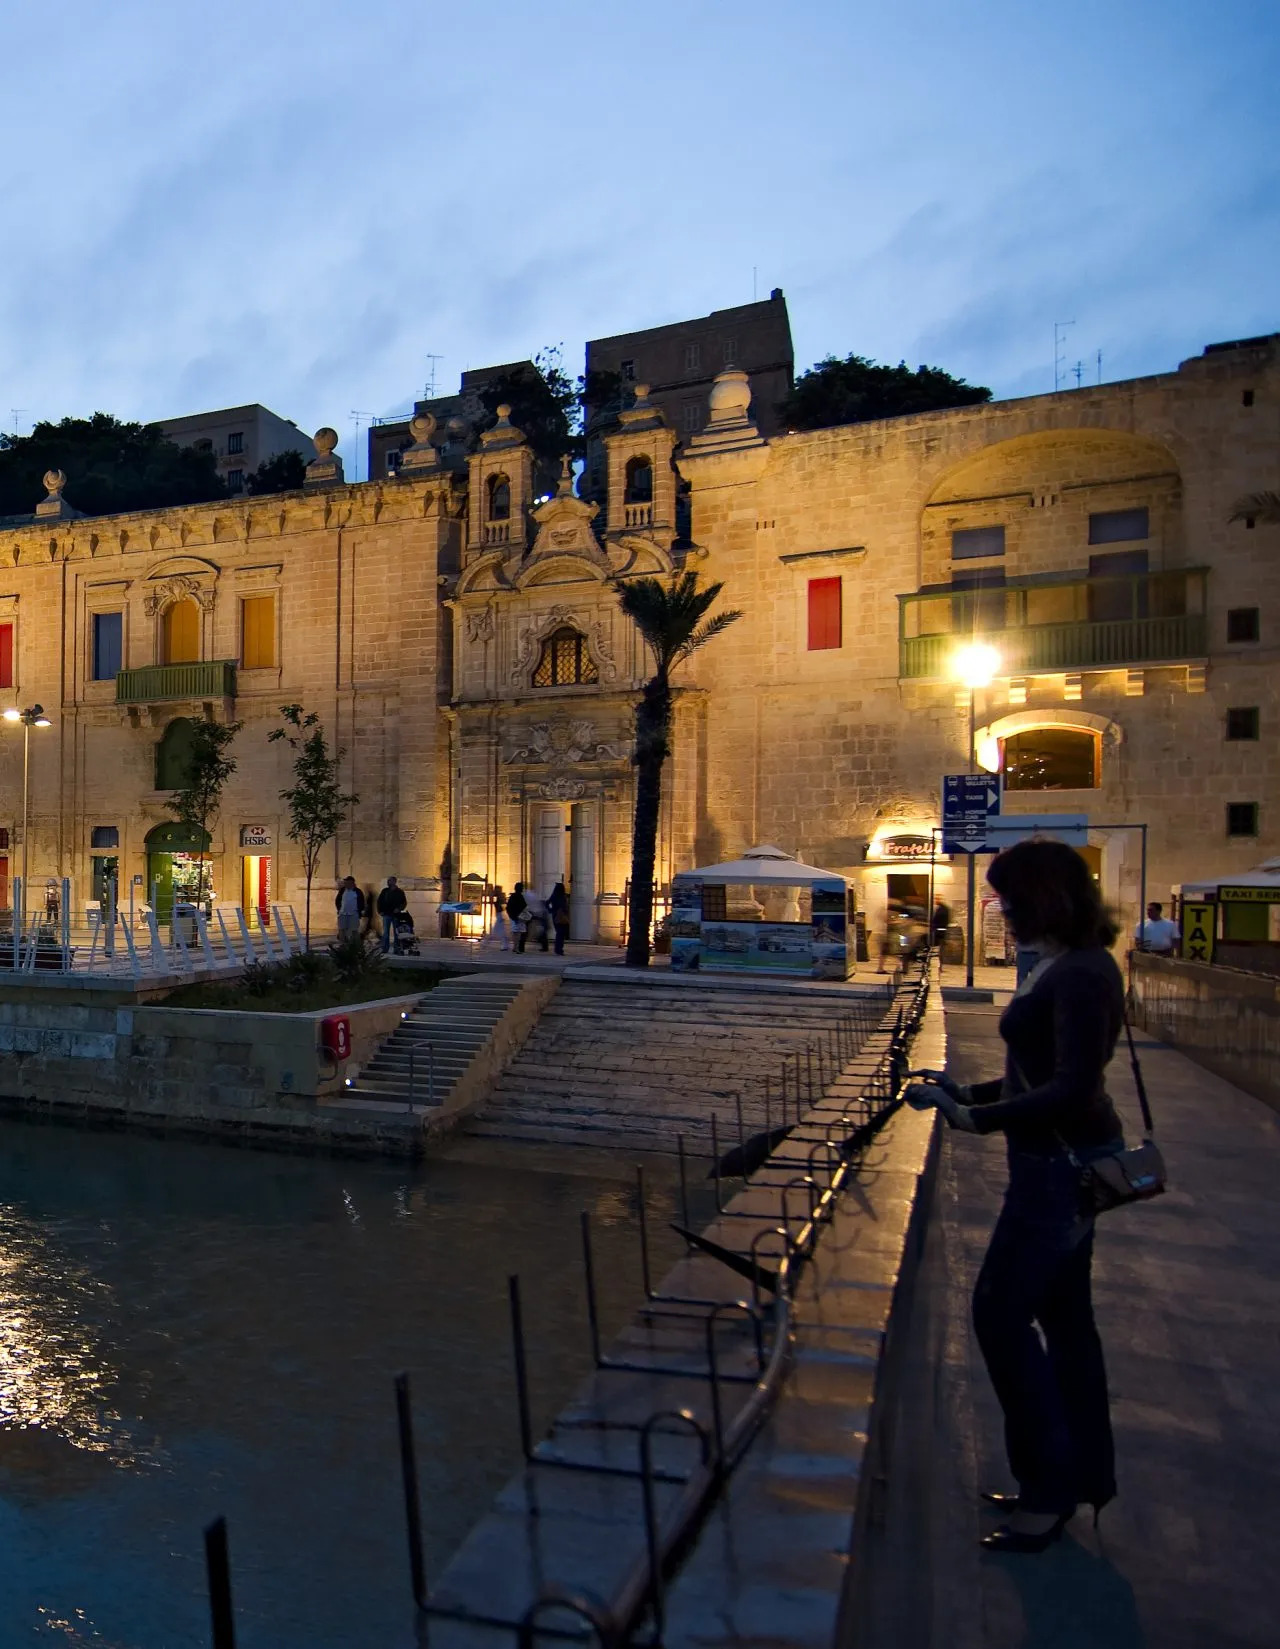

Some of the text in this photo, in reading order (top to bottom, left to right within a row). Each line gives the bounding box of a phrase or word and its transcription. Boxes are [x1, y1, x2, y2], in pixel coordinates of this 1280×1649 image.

[244, 836, 272, 845] HSBC
[885, 842, 934, 854] Fratell
[1224, 890, 1252, 899] TAXI
